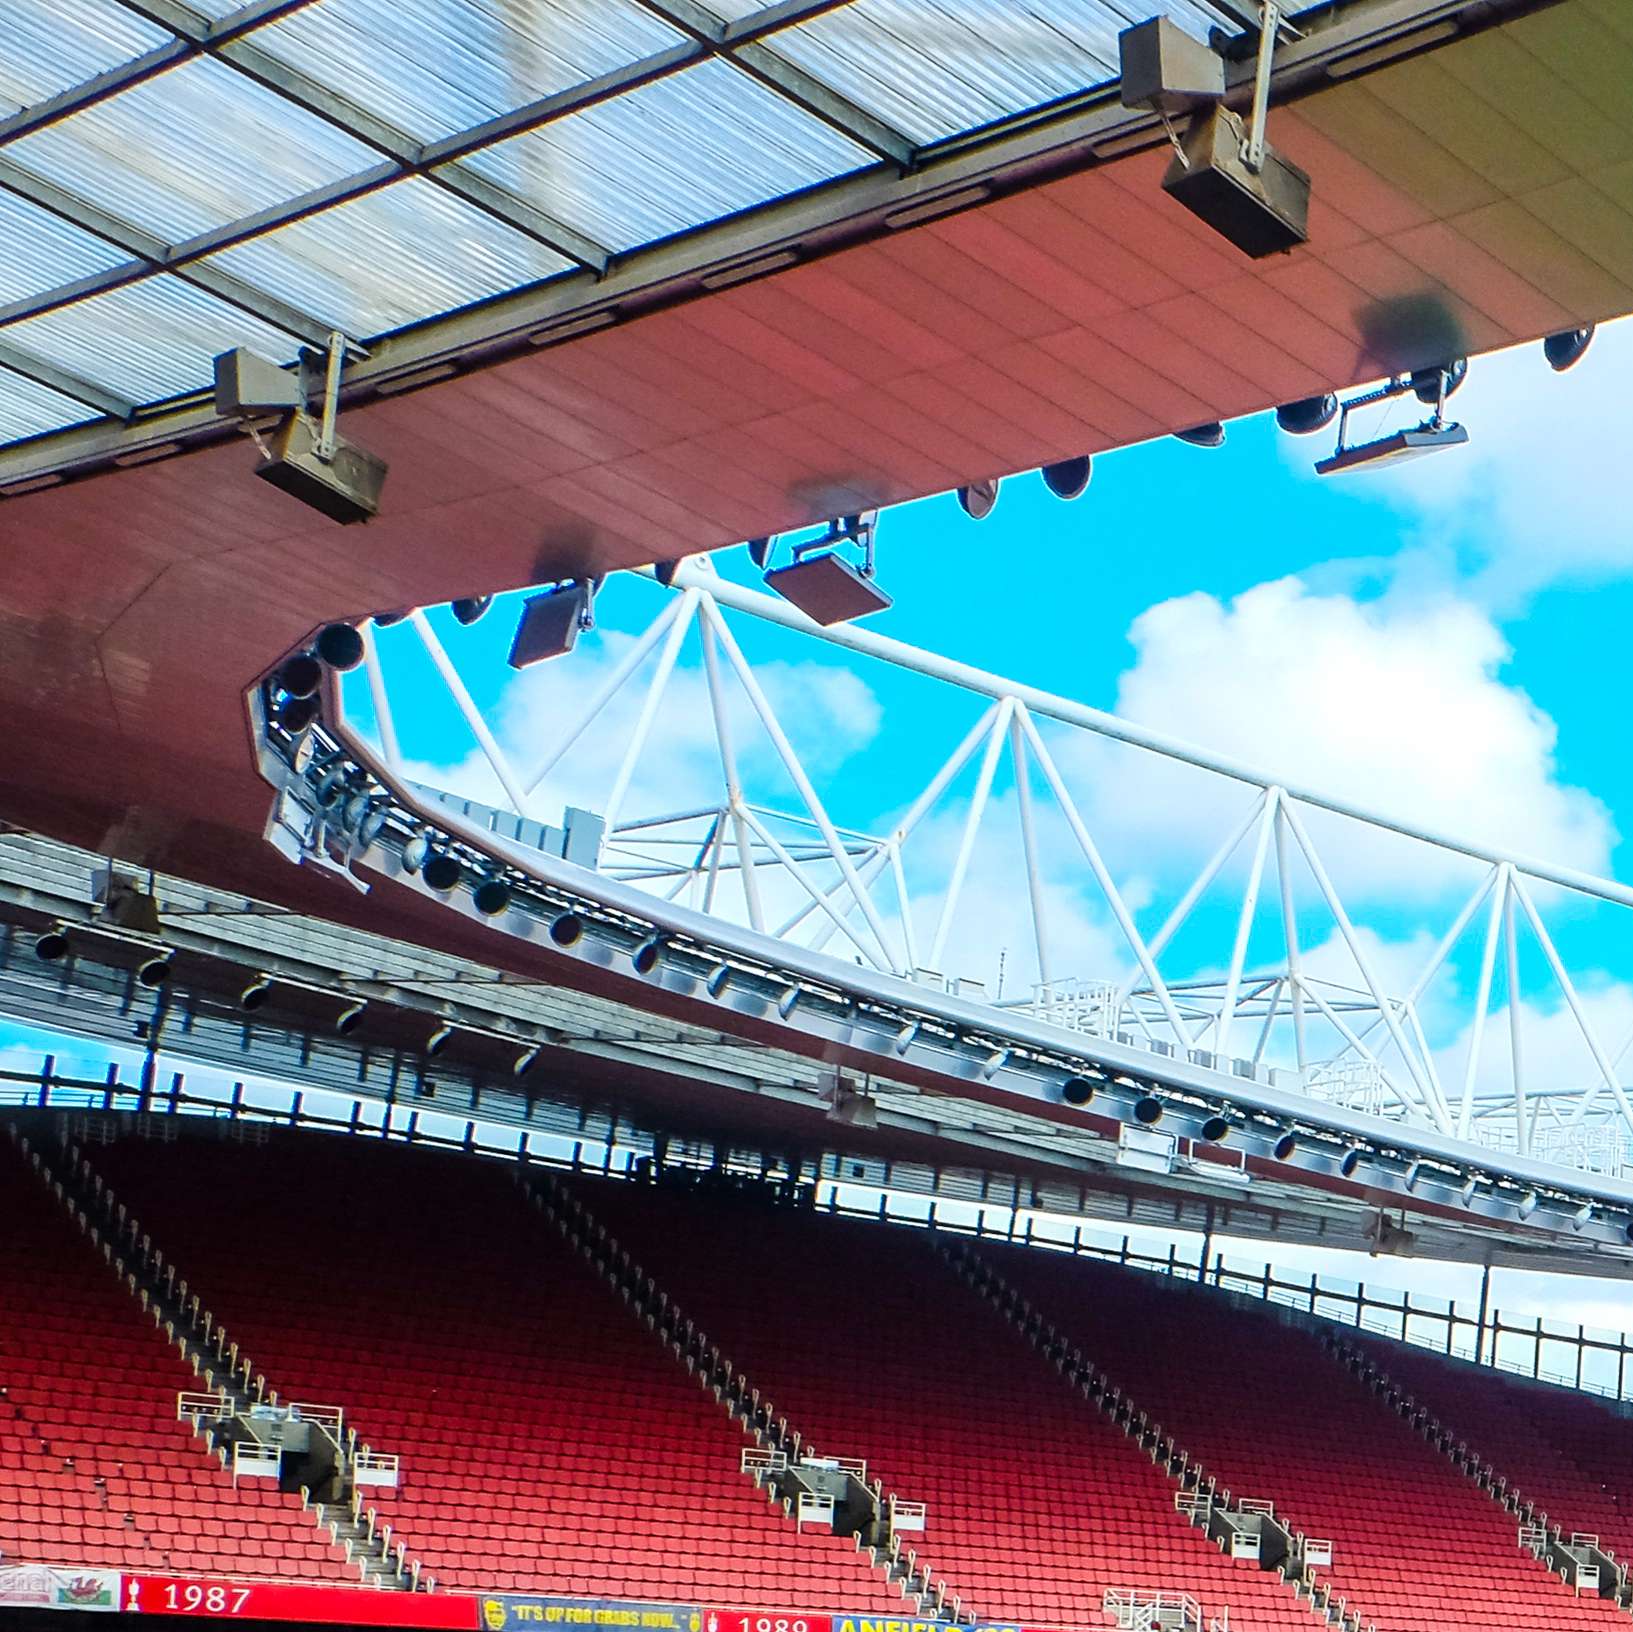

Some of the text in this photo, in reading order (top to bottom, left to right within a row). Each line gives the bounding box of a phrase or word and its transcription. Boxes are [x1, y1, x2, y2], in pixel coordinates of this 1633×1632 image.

[164, 1583, 251, 1613] 1987
[565, 1608, 592, 1624] FOR
[594, 1609, 640, 1626] GRABS
